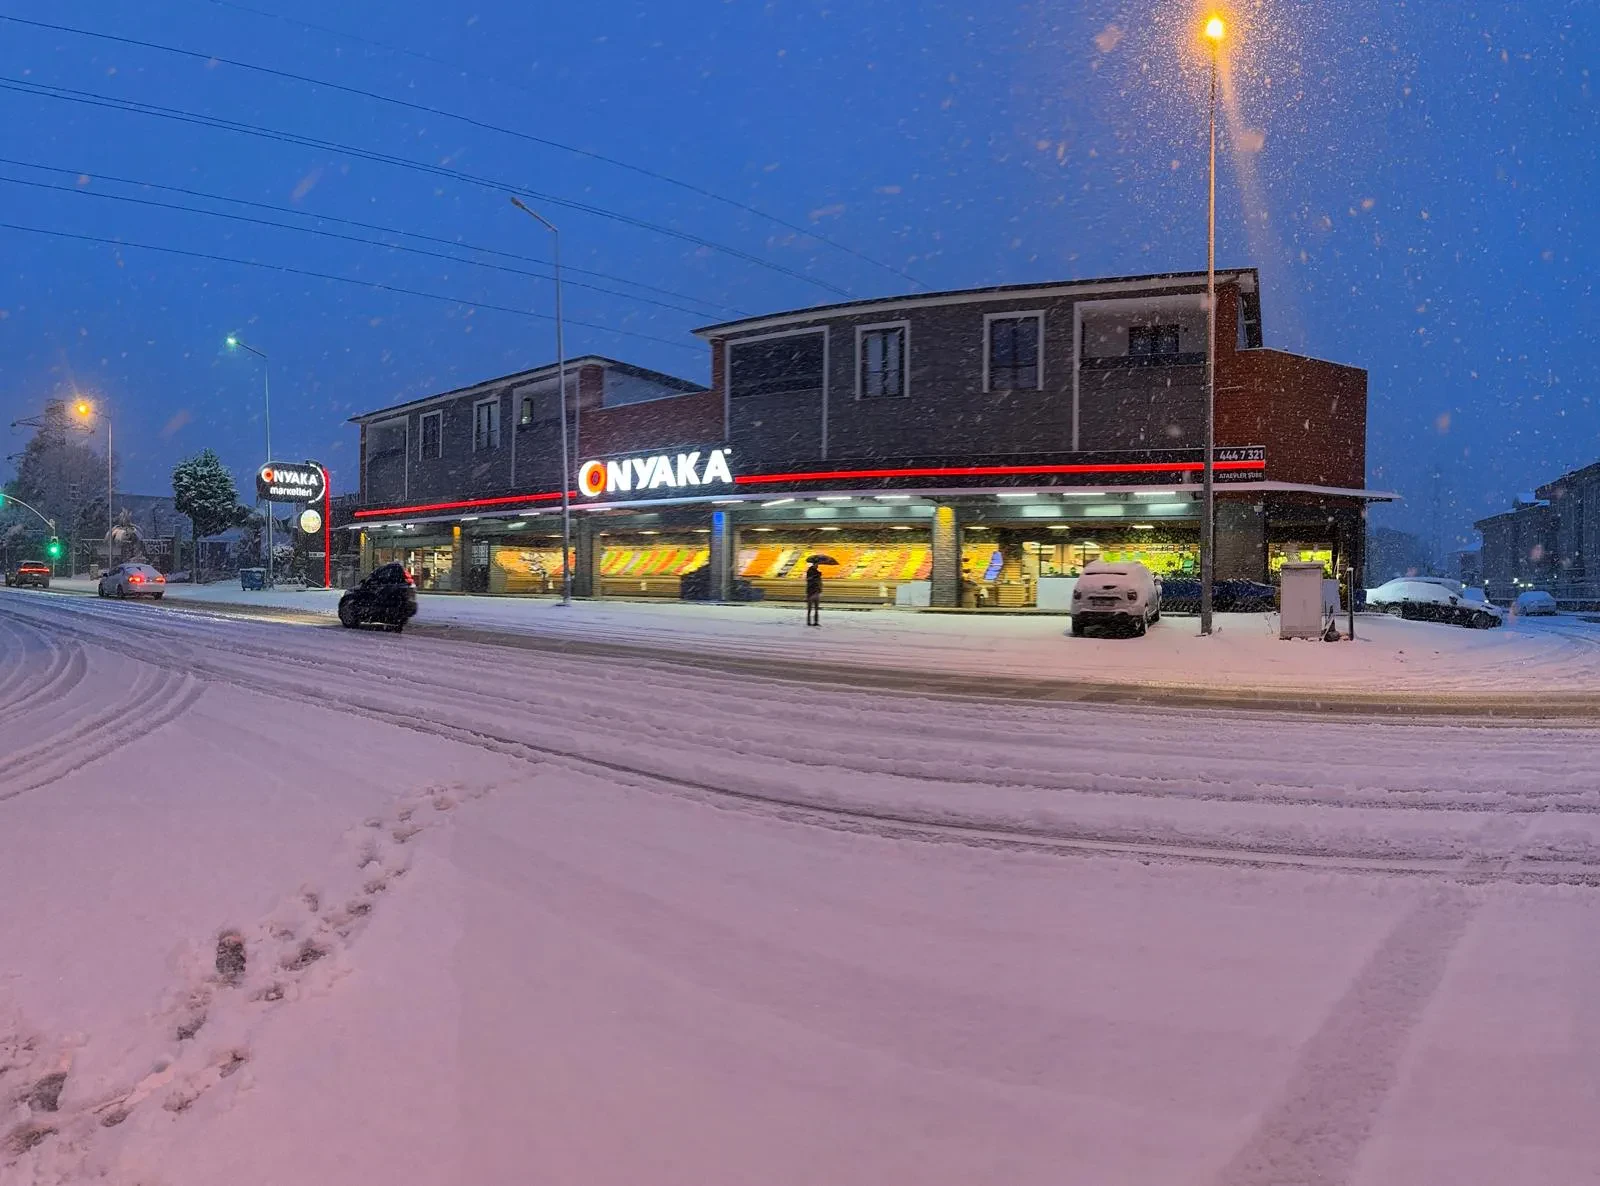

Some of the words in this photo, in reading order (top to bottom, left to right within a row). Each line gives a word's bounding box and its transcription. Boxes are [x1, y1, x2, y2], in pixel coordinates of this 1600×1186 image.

[1220, 451, 1238, 460] 444
[1240, 450, 1246, 459] 7
[1248, 450, 1263, 459] 321
[261, 468, 318, 486] ONYAKA
[578, 449, 732, 497] ONYAKA
